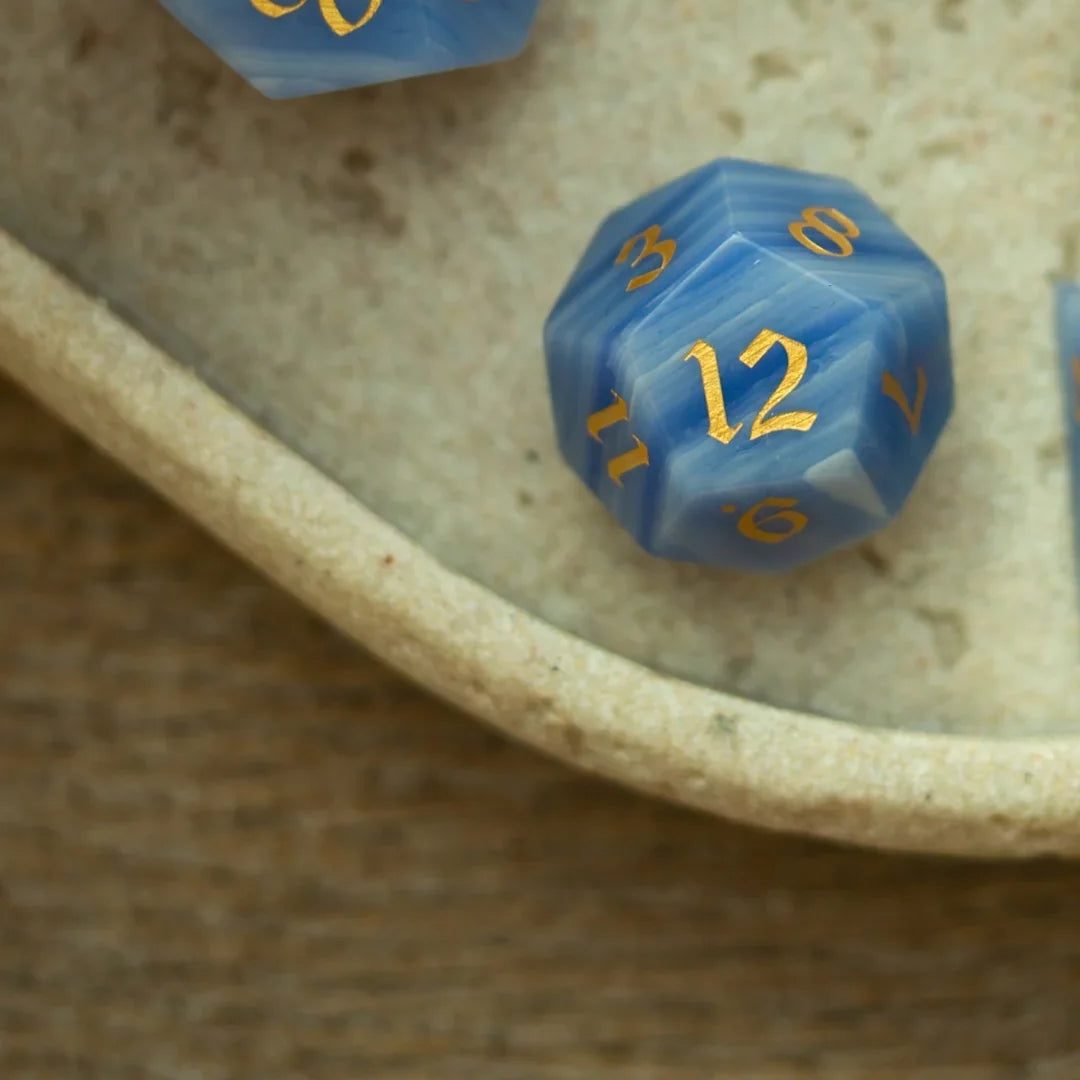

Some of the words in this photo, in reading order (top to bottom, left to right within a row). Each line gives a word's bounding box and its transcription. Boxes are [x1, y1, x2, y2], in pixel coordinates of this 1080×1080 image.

[614, 224, 678, 293] 3
[787, 206, 861, 258] 8
[683, 328, 819, 446] 12
[586, 389, 650, 488] 11
